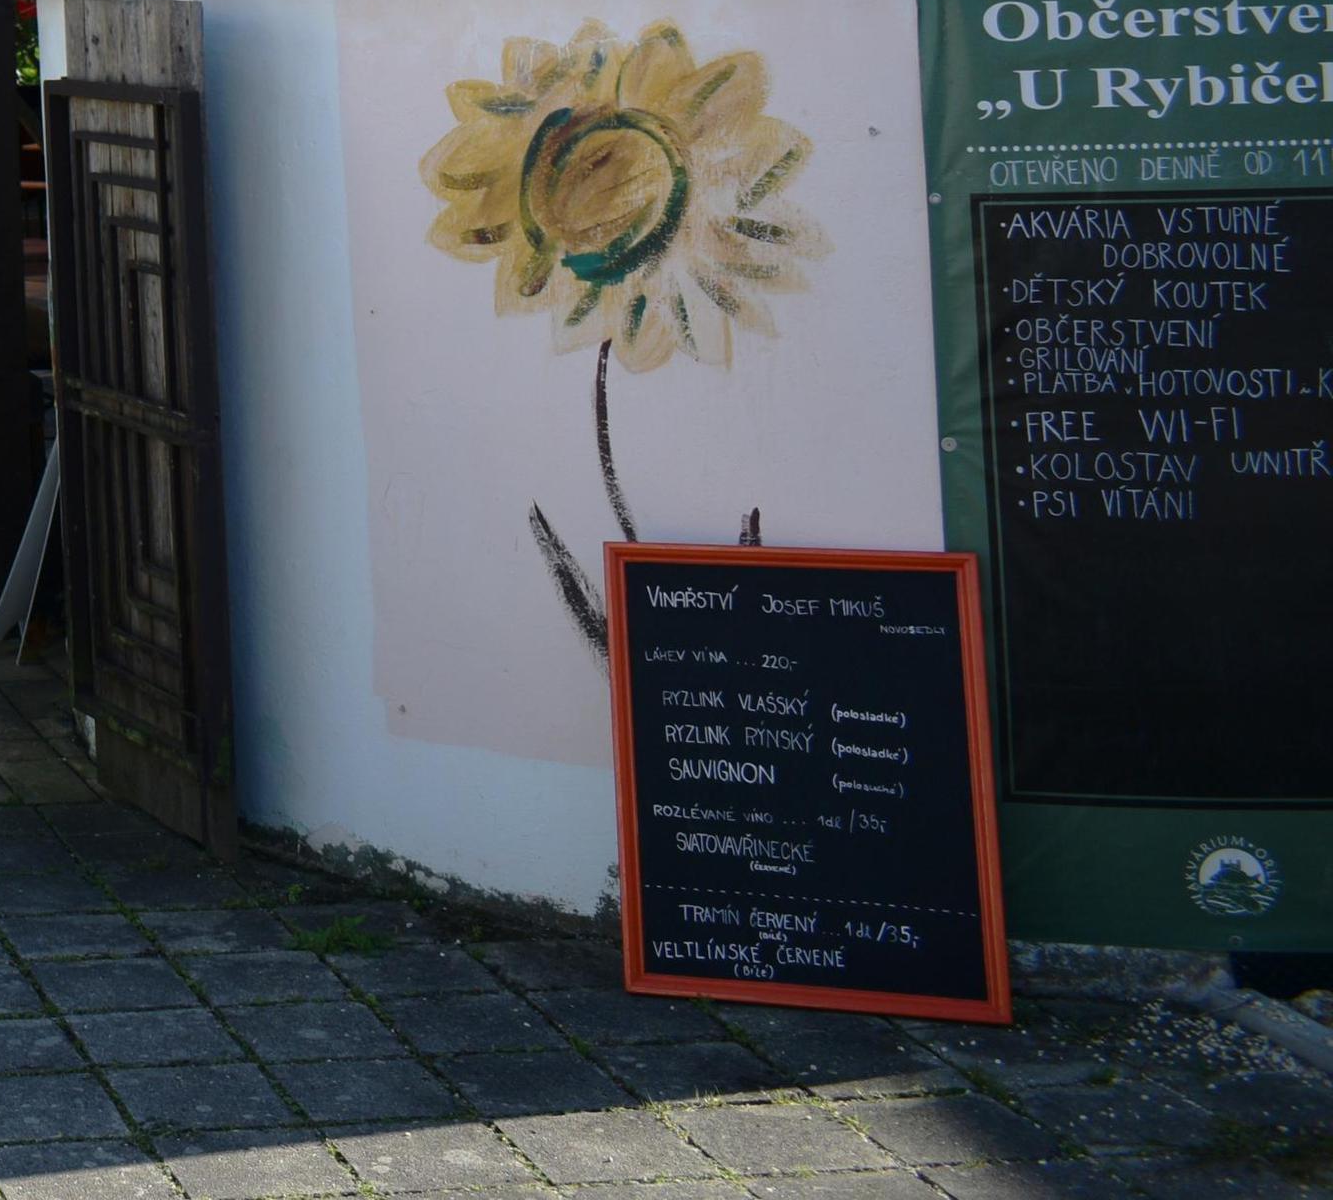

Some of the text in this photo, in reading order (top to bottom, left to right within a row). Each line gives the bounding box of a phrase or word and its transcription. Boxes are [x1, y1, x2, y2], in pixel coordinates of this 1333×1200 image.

[989, 154, 1119, 187] OTEVŘENO
[1141, 149, 1222, 181] DENNĚ
[1243, 149, 1273, 176] OD
[1006, 200, 1281, 240] AKVÁRIA VSTUPNÉ
[1102, 237, 1291, 273] DOBROVOLNÉ
[1012, 272, 1267, 311] DĚTSKÝ KOUTEK
[1015, 312, 1222, 349] OBČERSTVENÍ
[1018, 344, 1150, 373] GRILOVÁNÍ
[1023, 371, 1116, 395] PLATBA
[1138, 367, 1291, 399] HOTOVOSTI
[1026, 406, 1240, 444] FREE WI-FI
[1030, 439, 1333, 482] KOLOSTAV UVNITŘ
[1033, 490, 1076, 519] PSI
[646, 585, 885, 618] VINAŘSTVÍ JOSEF MIKUŠ
[662, 690, 725, 709] RYZLINK
[738, 688, 810, 717] VLAŠSKÝ
[664, 724, 732, 746] RYZLINK
[744, 720, 815, 754] RÝNSKÝ
[668, 757, 776, 785] SAUVIGNON
[653, 802, 736, 823] ROZLÉVANÉ
[676, 831, 816, 864] SVATOVAVŘINECKÉ
[678, 902, 741, 927] TRAMÍN
[749, 910, 819, 934] ČERVENÝ
[652, 937, 846, 969] VELTLÍNSKÉ ČERVENÉ
